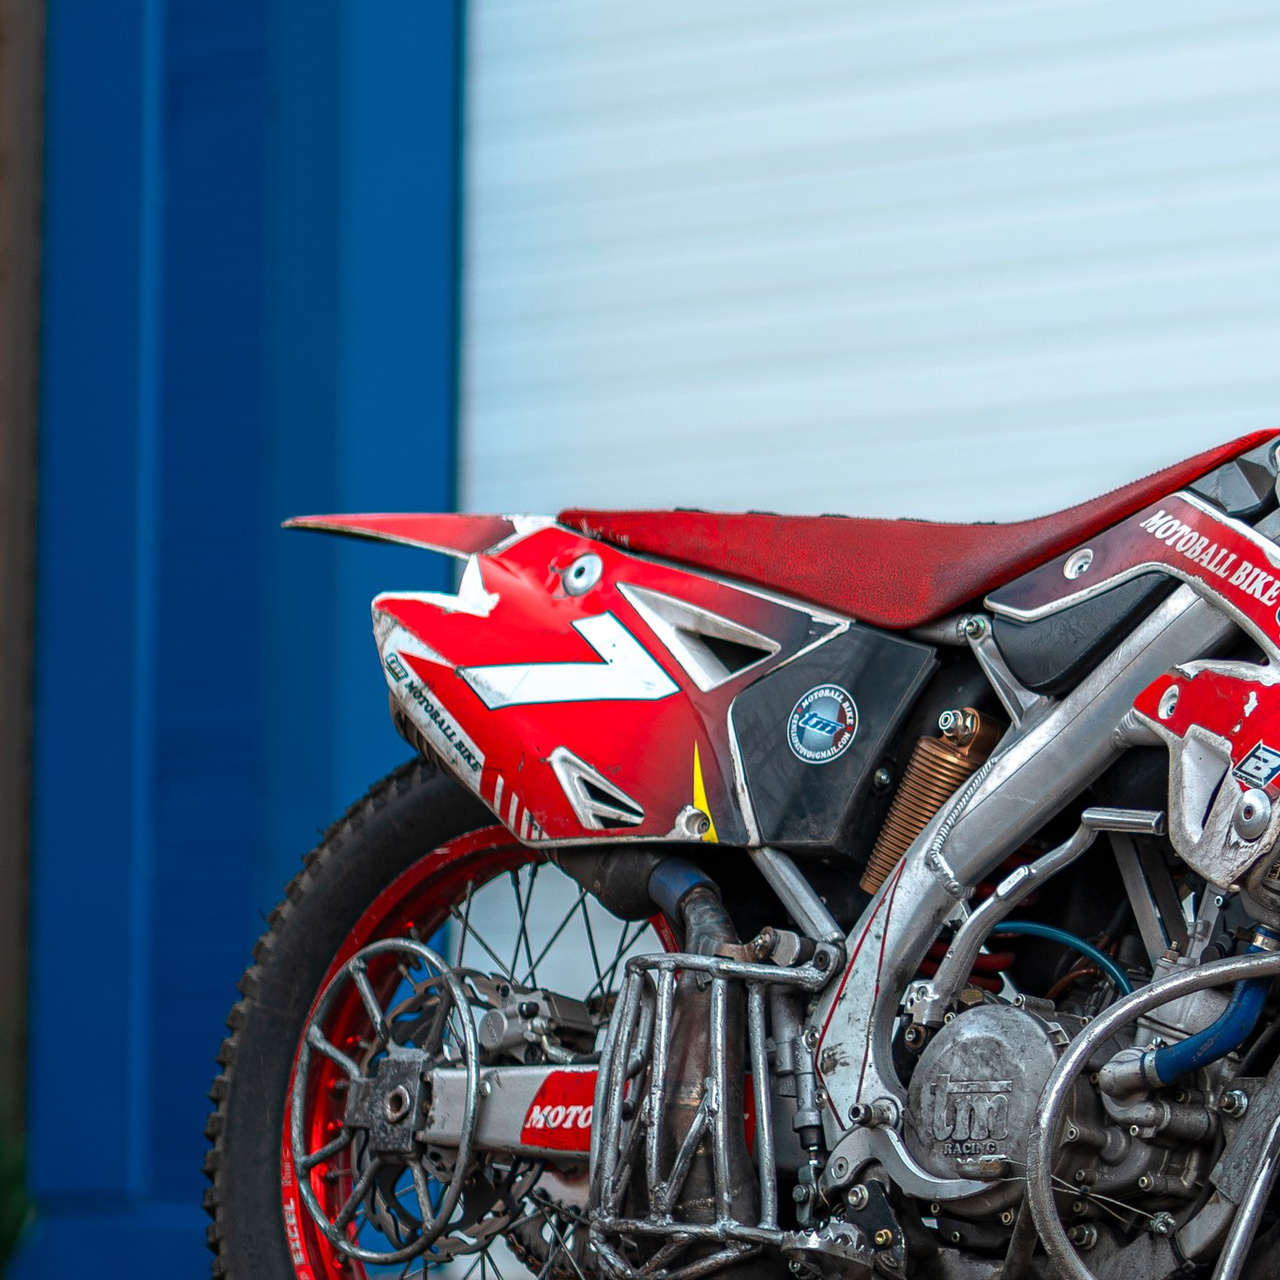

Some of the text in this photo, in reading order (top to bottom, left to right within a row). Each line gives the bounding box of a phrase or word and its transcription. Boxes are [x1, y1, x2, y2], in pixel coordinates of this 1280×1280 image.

[1139, 509, 1239, 577] MOTOBALL
[404, 680, 483, 773] MOTOBALL BIKE
[801, 689, 854, 726] MOTOBALL BIKE
[943, 1141, 998, 1156] RACING
[283, 1197, 305, 1265] EXCEL
